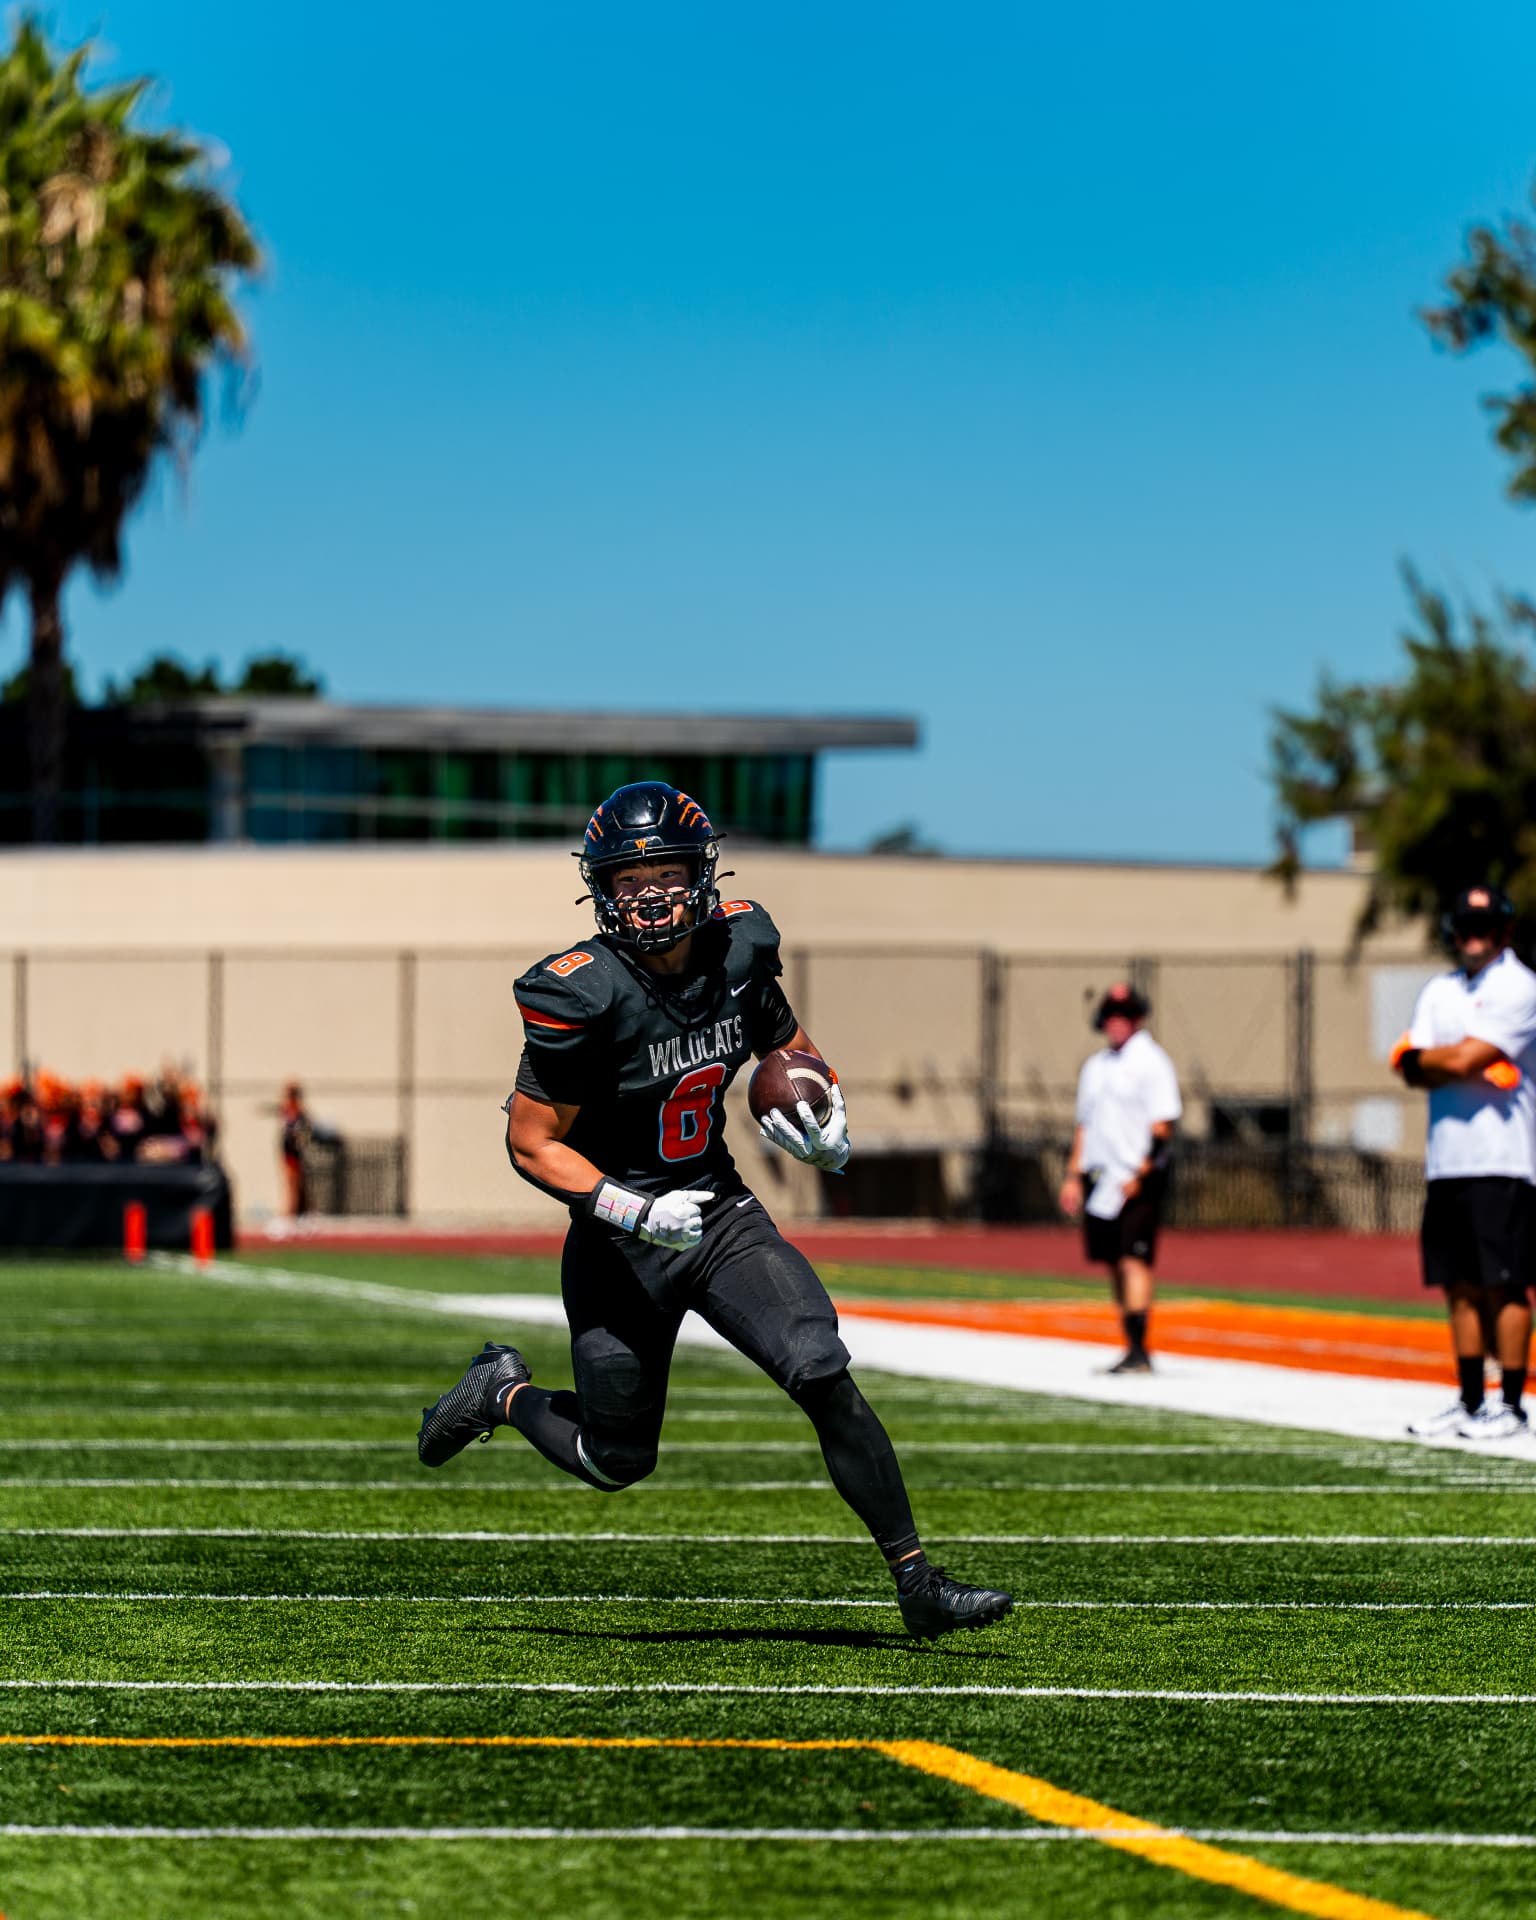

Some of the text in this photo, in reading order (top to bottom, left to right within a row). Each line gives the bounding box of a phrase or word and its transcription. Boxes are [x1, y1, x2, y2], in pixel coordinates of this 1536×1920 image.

[634, 839, 647, 849] W
[714, 901, 754, 920] 8
[545, 951, 595, 977] 8
[649, 1015, 743, 1077] WILDCATS
[658, 1063, 727, 1163] 8
